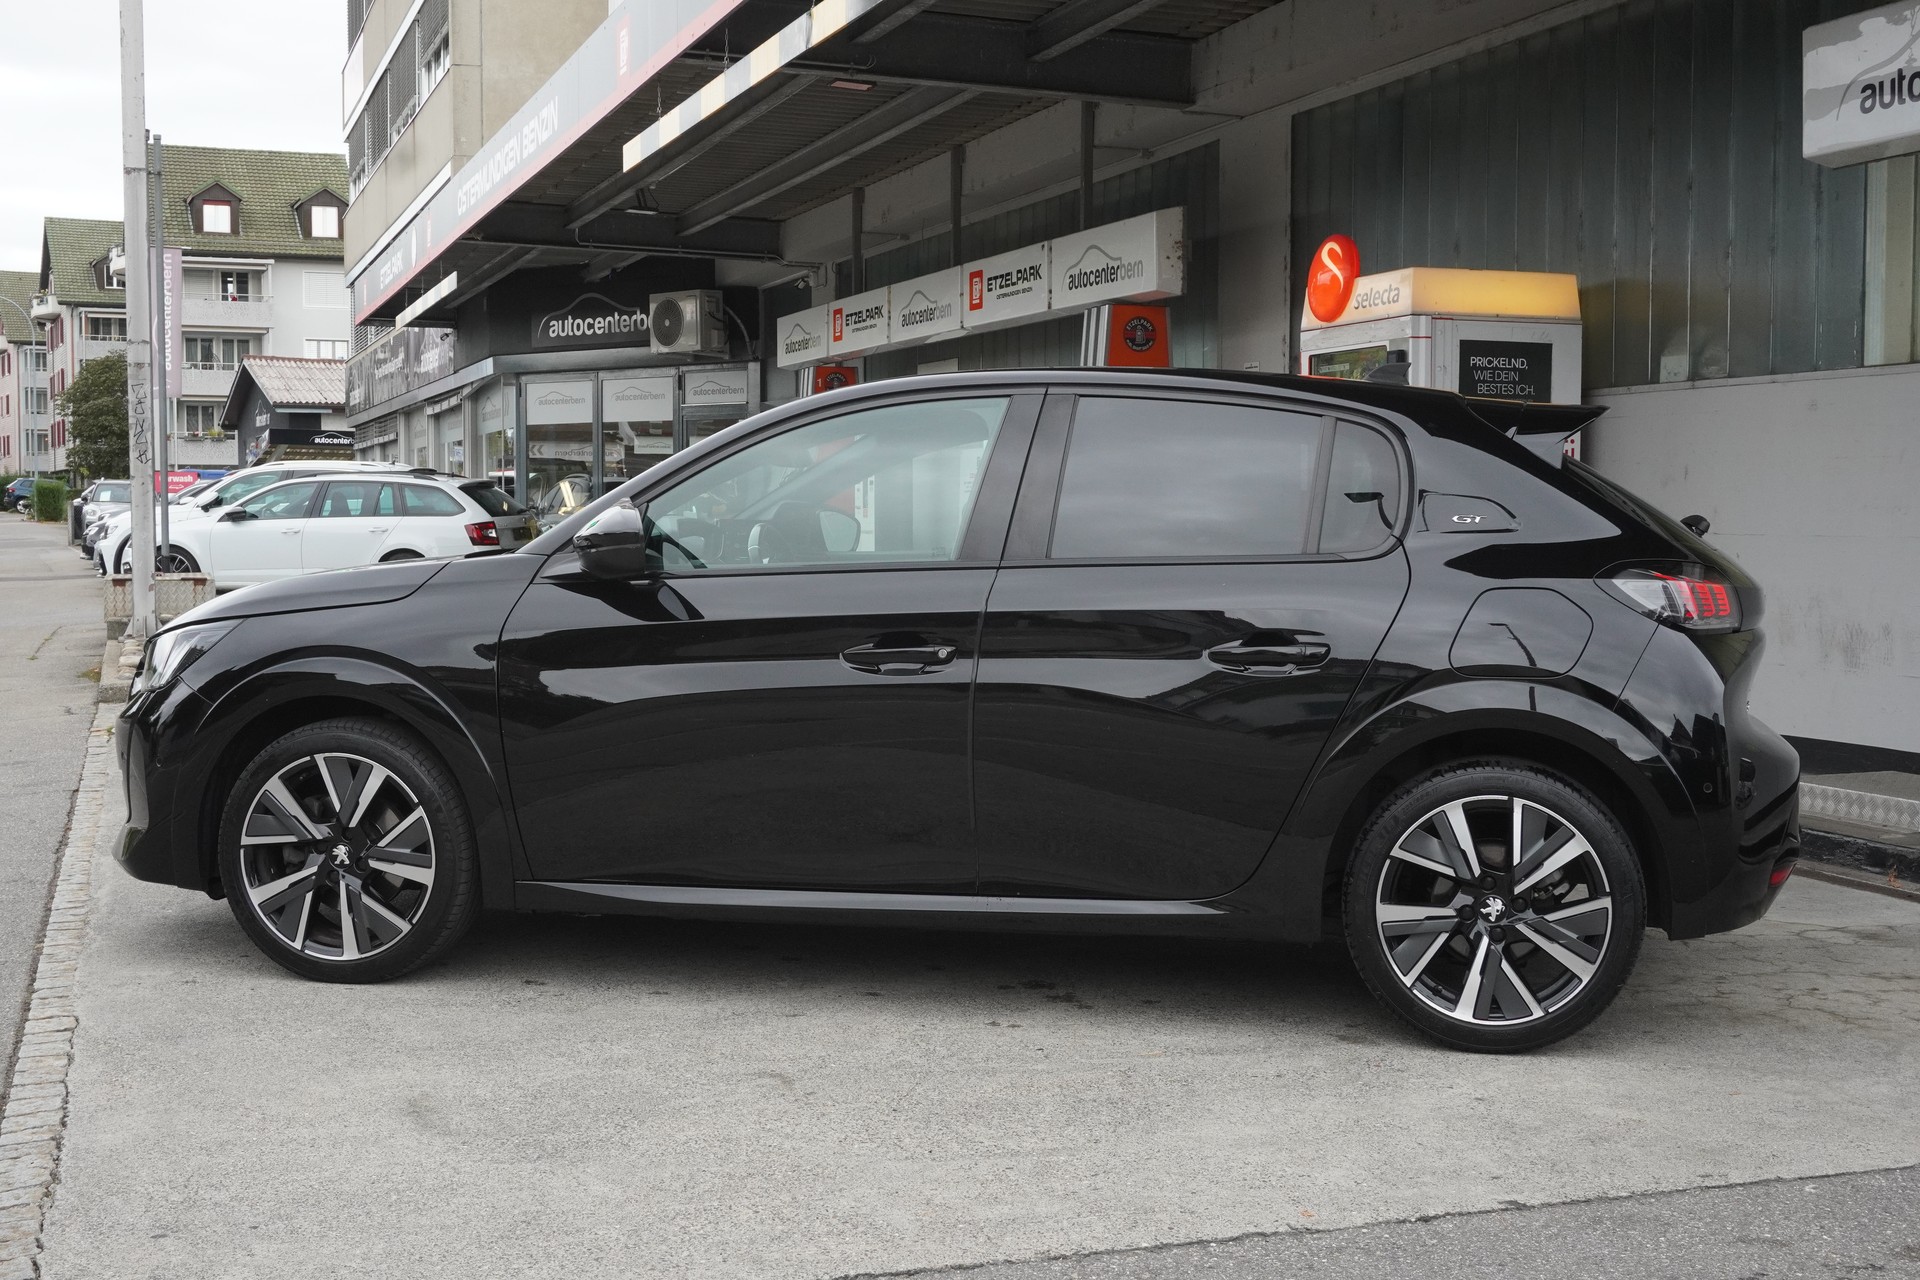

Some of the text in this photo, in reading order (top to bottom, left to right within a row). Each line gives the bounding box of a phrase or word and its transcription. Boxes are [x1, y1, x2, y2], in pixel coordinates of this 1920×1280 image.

[457, 95, 559, 216] OSTERMUNDIGEN BENZIN
[986, 263, 1043, 292] ETZELPARK
[1068, 257, 1144, 291] autocenterbern
[1353, 284, 1401, 310] selecta
[845, 304, 884, 327] ETZELPARK
[901, 300, 952, 328] autocenterbern
[549, 309, 651, 338] autocenterb
[1470, 356, 1529, 370] PRICKELND,
[1473, 370, 1519, 382] WIE DEIN
[614, 391, 666, 402] autocenterbern
[693, 386, 745, 396] autocenterbern
[1477, 383, 1536, 396] BESTES ICH.
[538, 395, 586, 406] autocenterbern
[1451, 513, 1488, 524] GT
